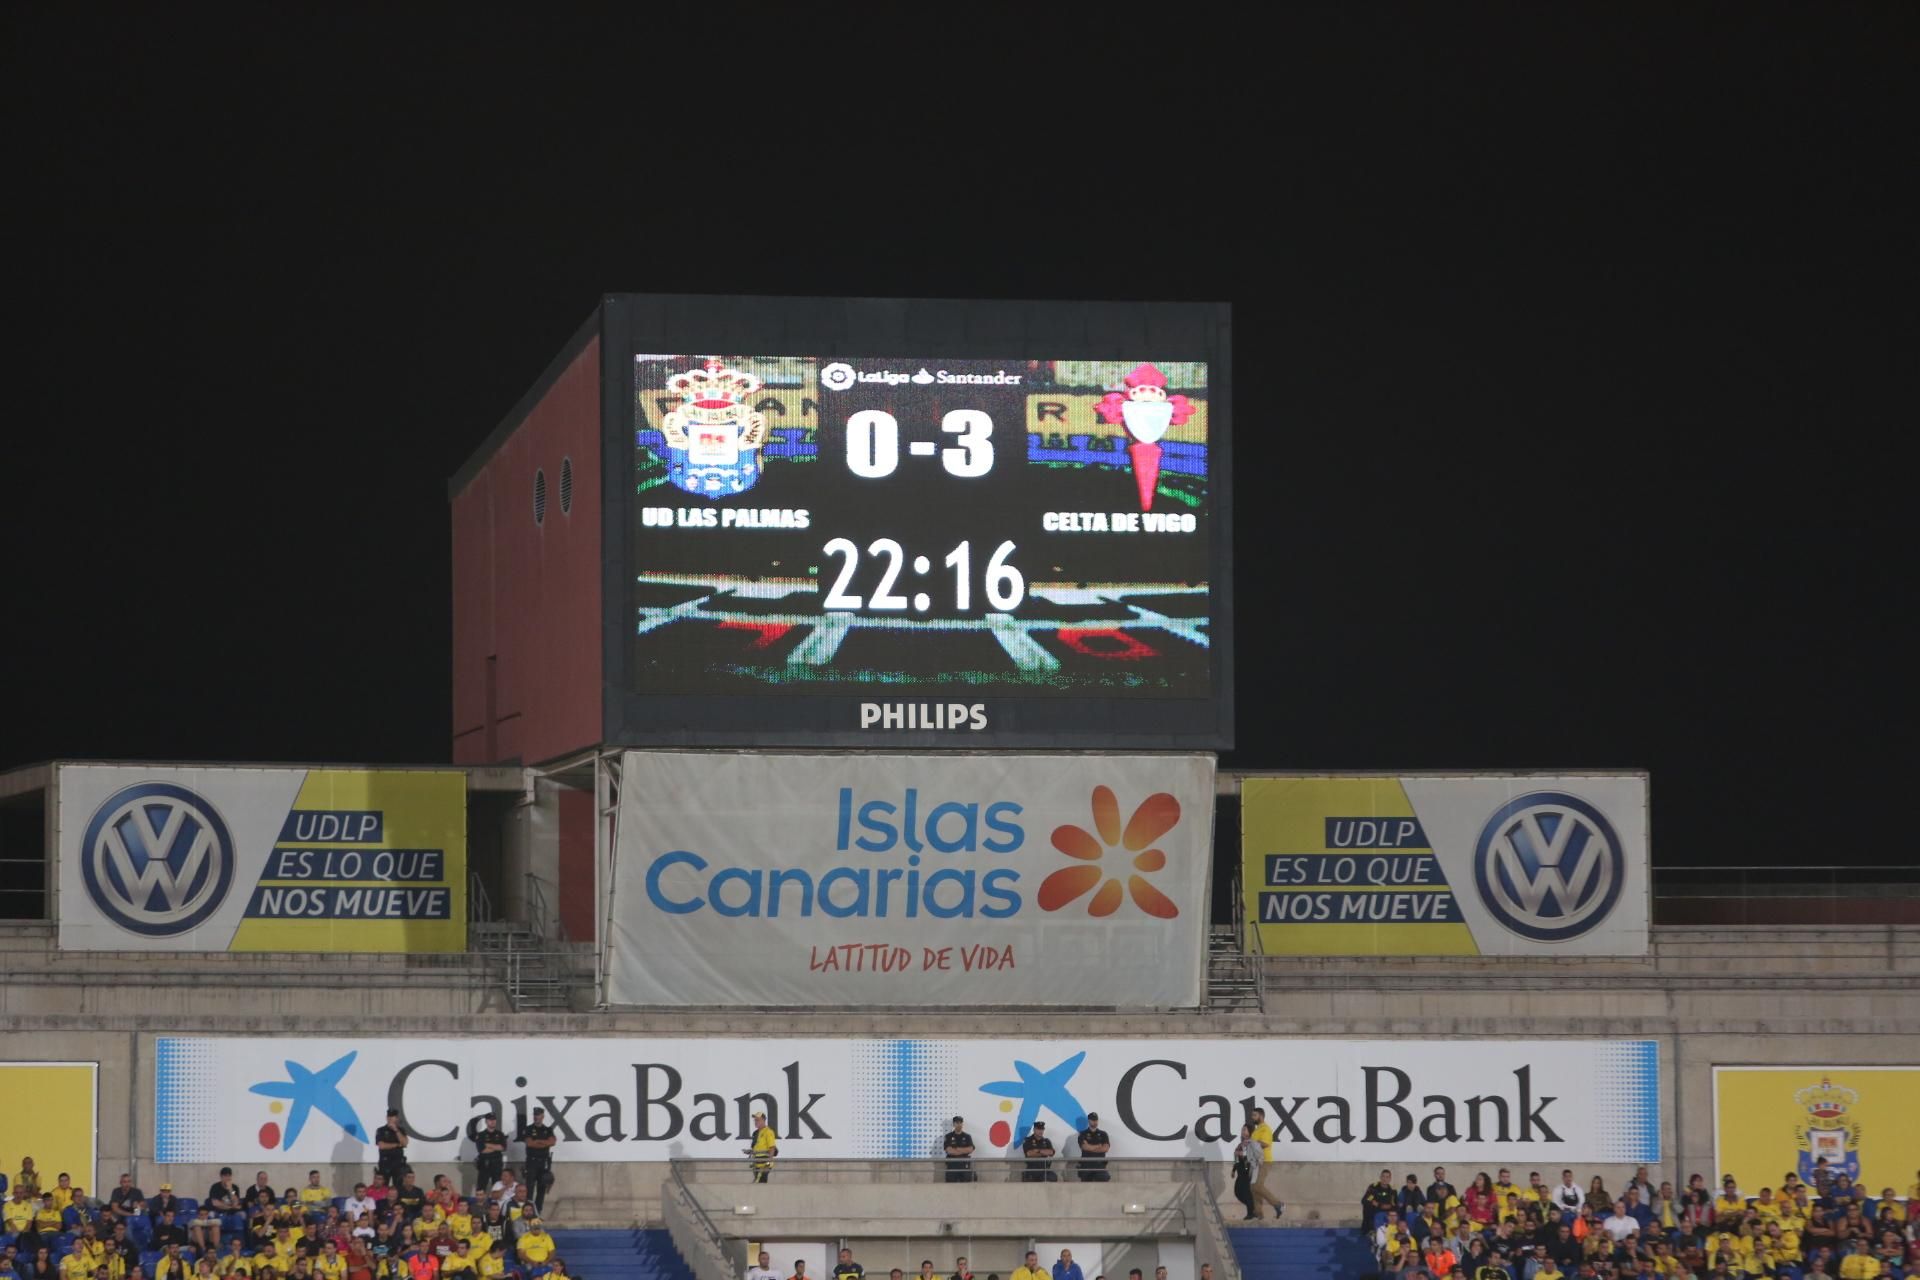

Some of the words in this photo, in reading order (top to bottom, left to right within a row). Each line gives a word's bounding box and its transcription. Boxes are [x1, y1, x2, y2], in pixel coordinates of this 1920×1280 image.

[857, 371, 910, 385] LaLiga
[937, 370, 1022, 384] Santander
[642, 507, 673, 526] UD
[677, 507, 718, 527] LAS
[721, 508, 810, 528] PALMAS
[1043, 512, 1108, 531] CELTA
[1111, 513, 1140, 532] DE
[1142, 513, 1196, 532] VIGO
[821, 537, 1025, 613] 22:16
[861, 703, 988, 730] PHILIPS
[295, 814, 378, 840] UDLP
[837, 787, 1026, 853] Islas
[1333, 820, 1416, 847] UDLP
[278, 851, 313, 878] ES
[321, 851, 362, 878] LO
[372, 851, 439, 882] QUE
[1272, 857, 1307, 883] ES
[1318, 857, 1357, 883] LO
[1367, 857, 1433, 887] QUE
[645, 850, 1023, 919] Canarias
[259, 889, 325, 915] NOS
[334, 889, 446, 916] MUEVE
[1265, 894, 1331, 920] NOS
[1339, 894, 1451, 920] MUEVE
[809, 943, 912, 972] LATITUD
[922, 947, 952, 971] DE
[960, 944, 1016, 972] VIDA
[387, 1059, 833, 1143] CaixaBank
[1116, 1059, 1566, 1144] CaixaBank
